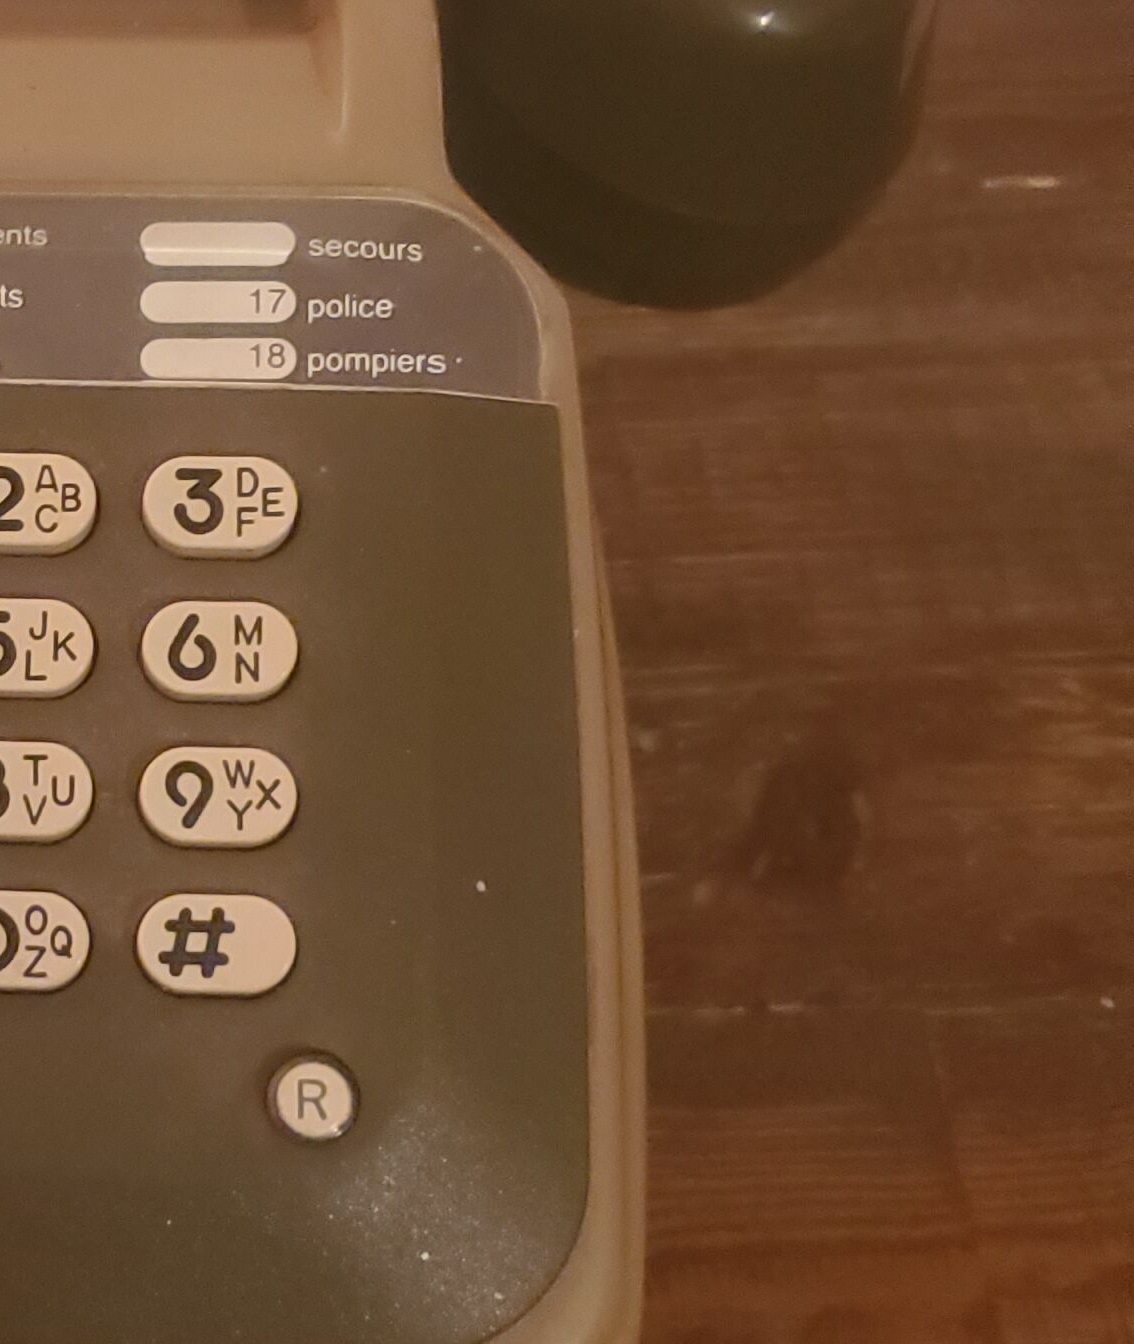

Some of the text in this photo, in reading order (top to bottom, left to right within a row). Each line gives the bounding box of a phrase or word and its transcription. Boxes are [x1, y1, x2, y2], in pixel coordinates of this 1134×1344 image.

[308, 236, 424, 263] secours
[249, 288, 394, 324] 17 police
[249, 343, 447, 378] 18 pompiers
[173, 467, 224, 535] 3
[167, 613, 217, 682] 6
[164, 760, 214, 829] 9
[296, 1078, 328, 1121] R
